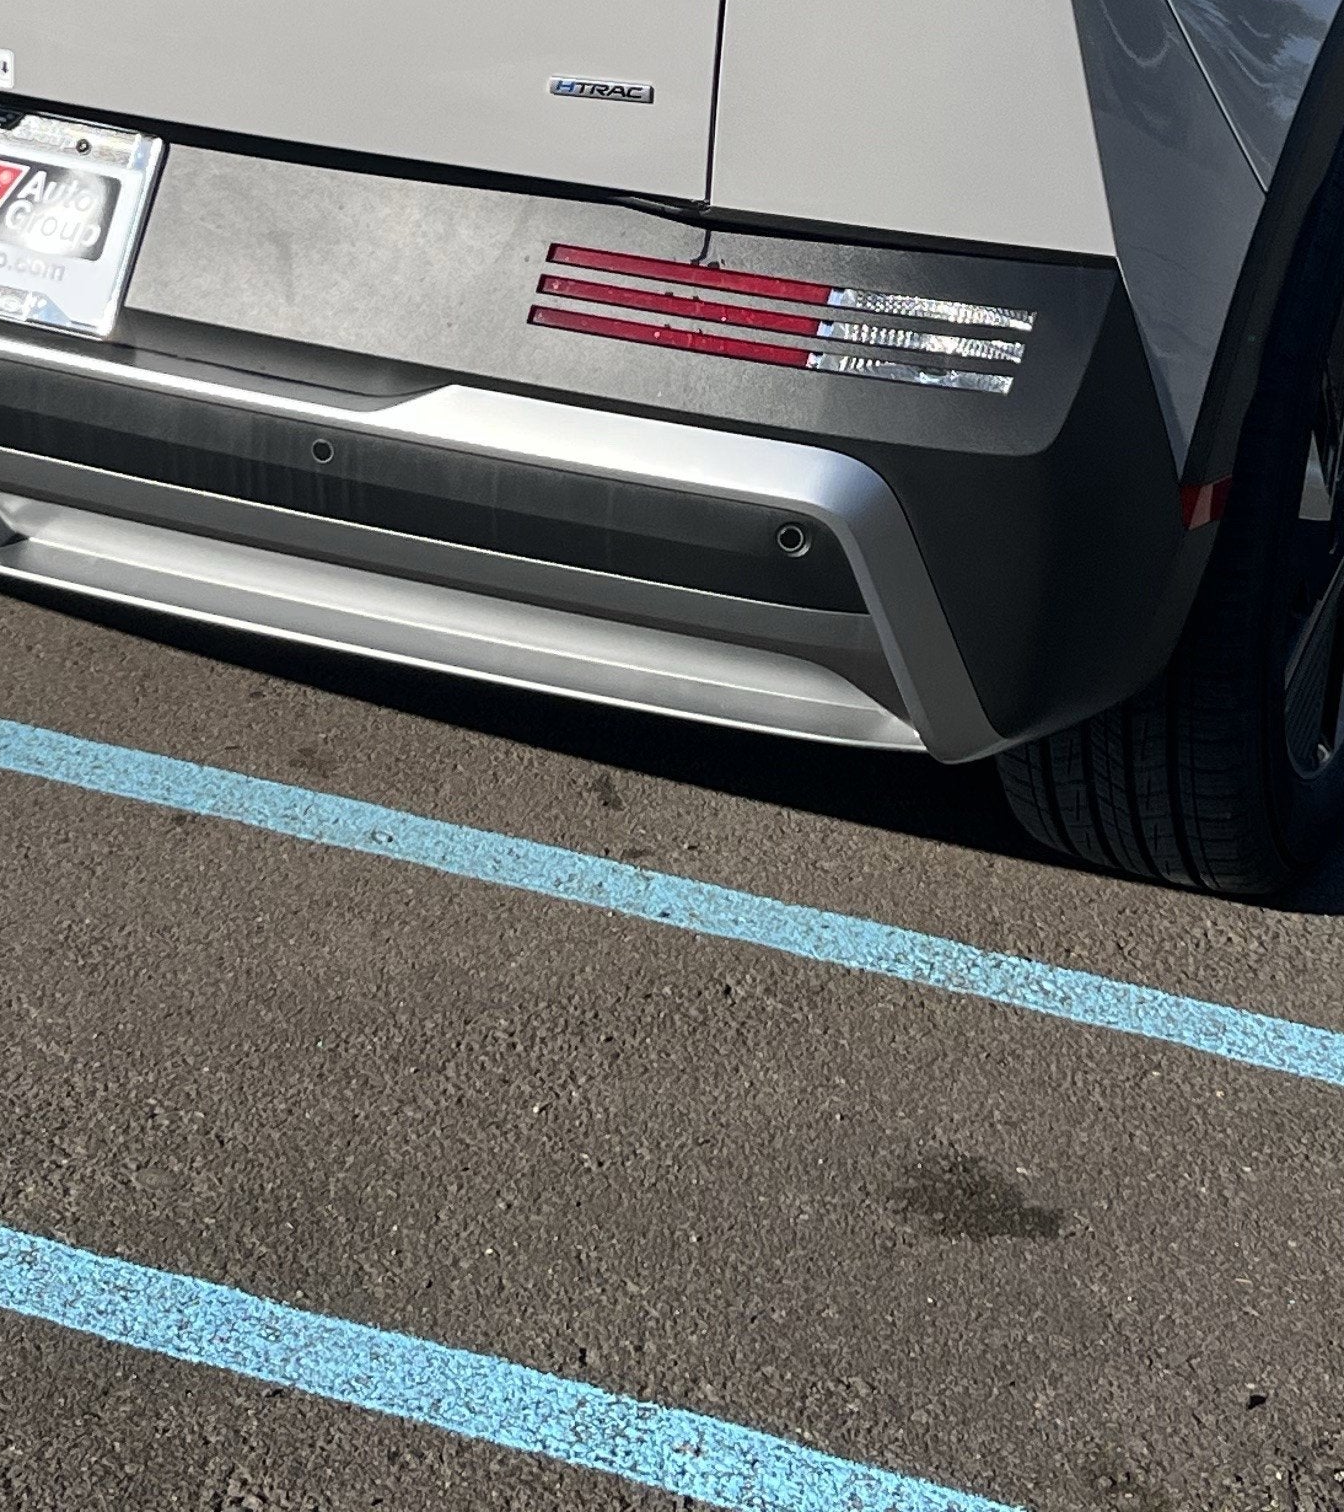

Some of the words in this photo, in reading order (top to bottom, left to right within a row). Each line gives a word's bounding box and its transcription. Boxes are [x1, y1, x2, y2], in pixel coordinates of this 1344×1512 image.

[555, 80, 643, 100] HTRAC
[17, 170, 94, 212] Auto
[5, 199, 102, 250] Group
